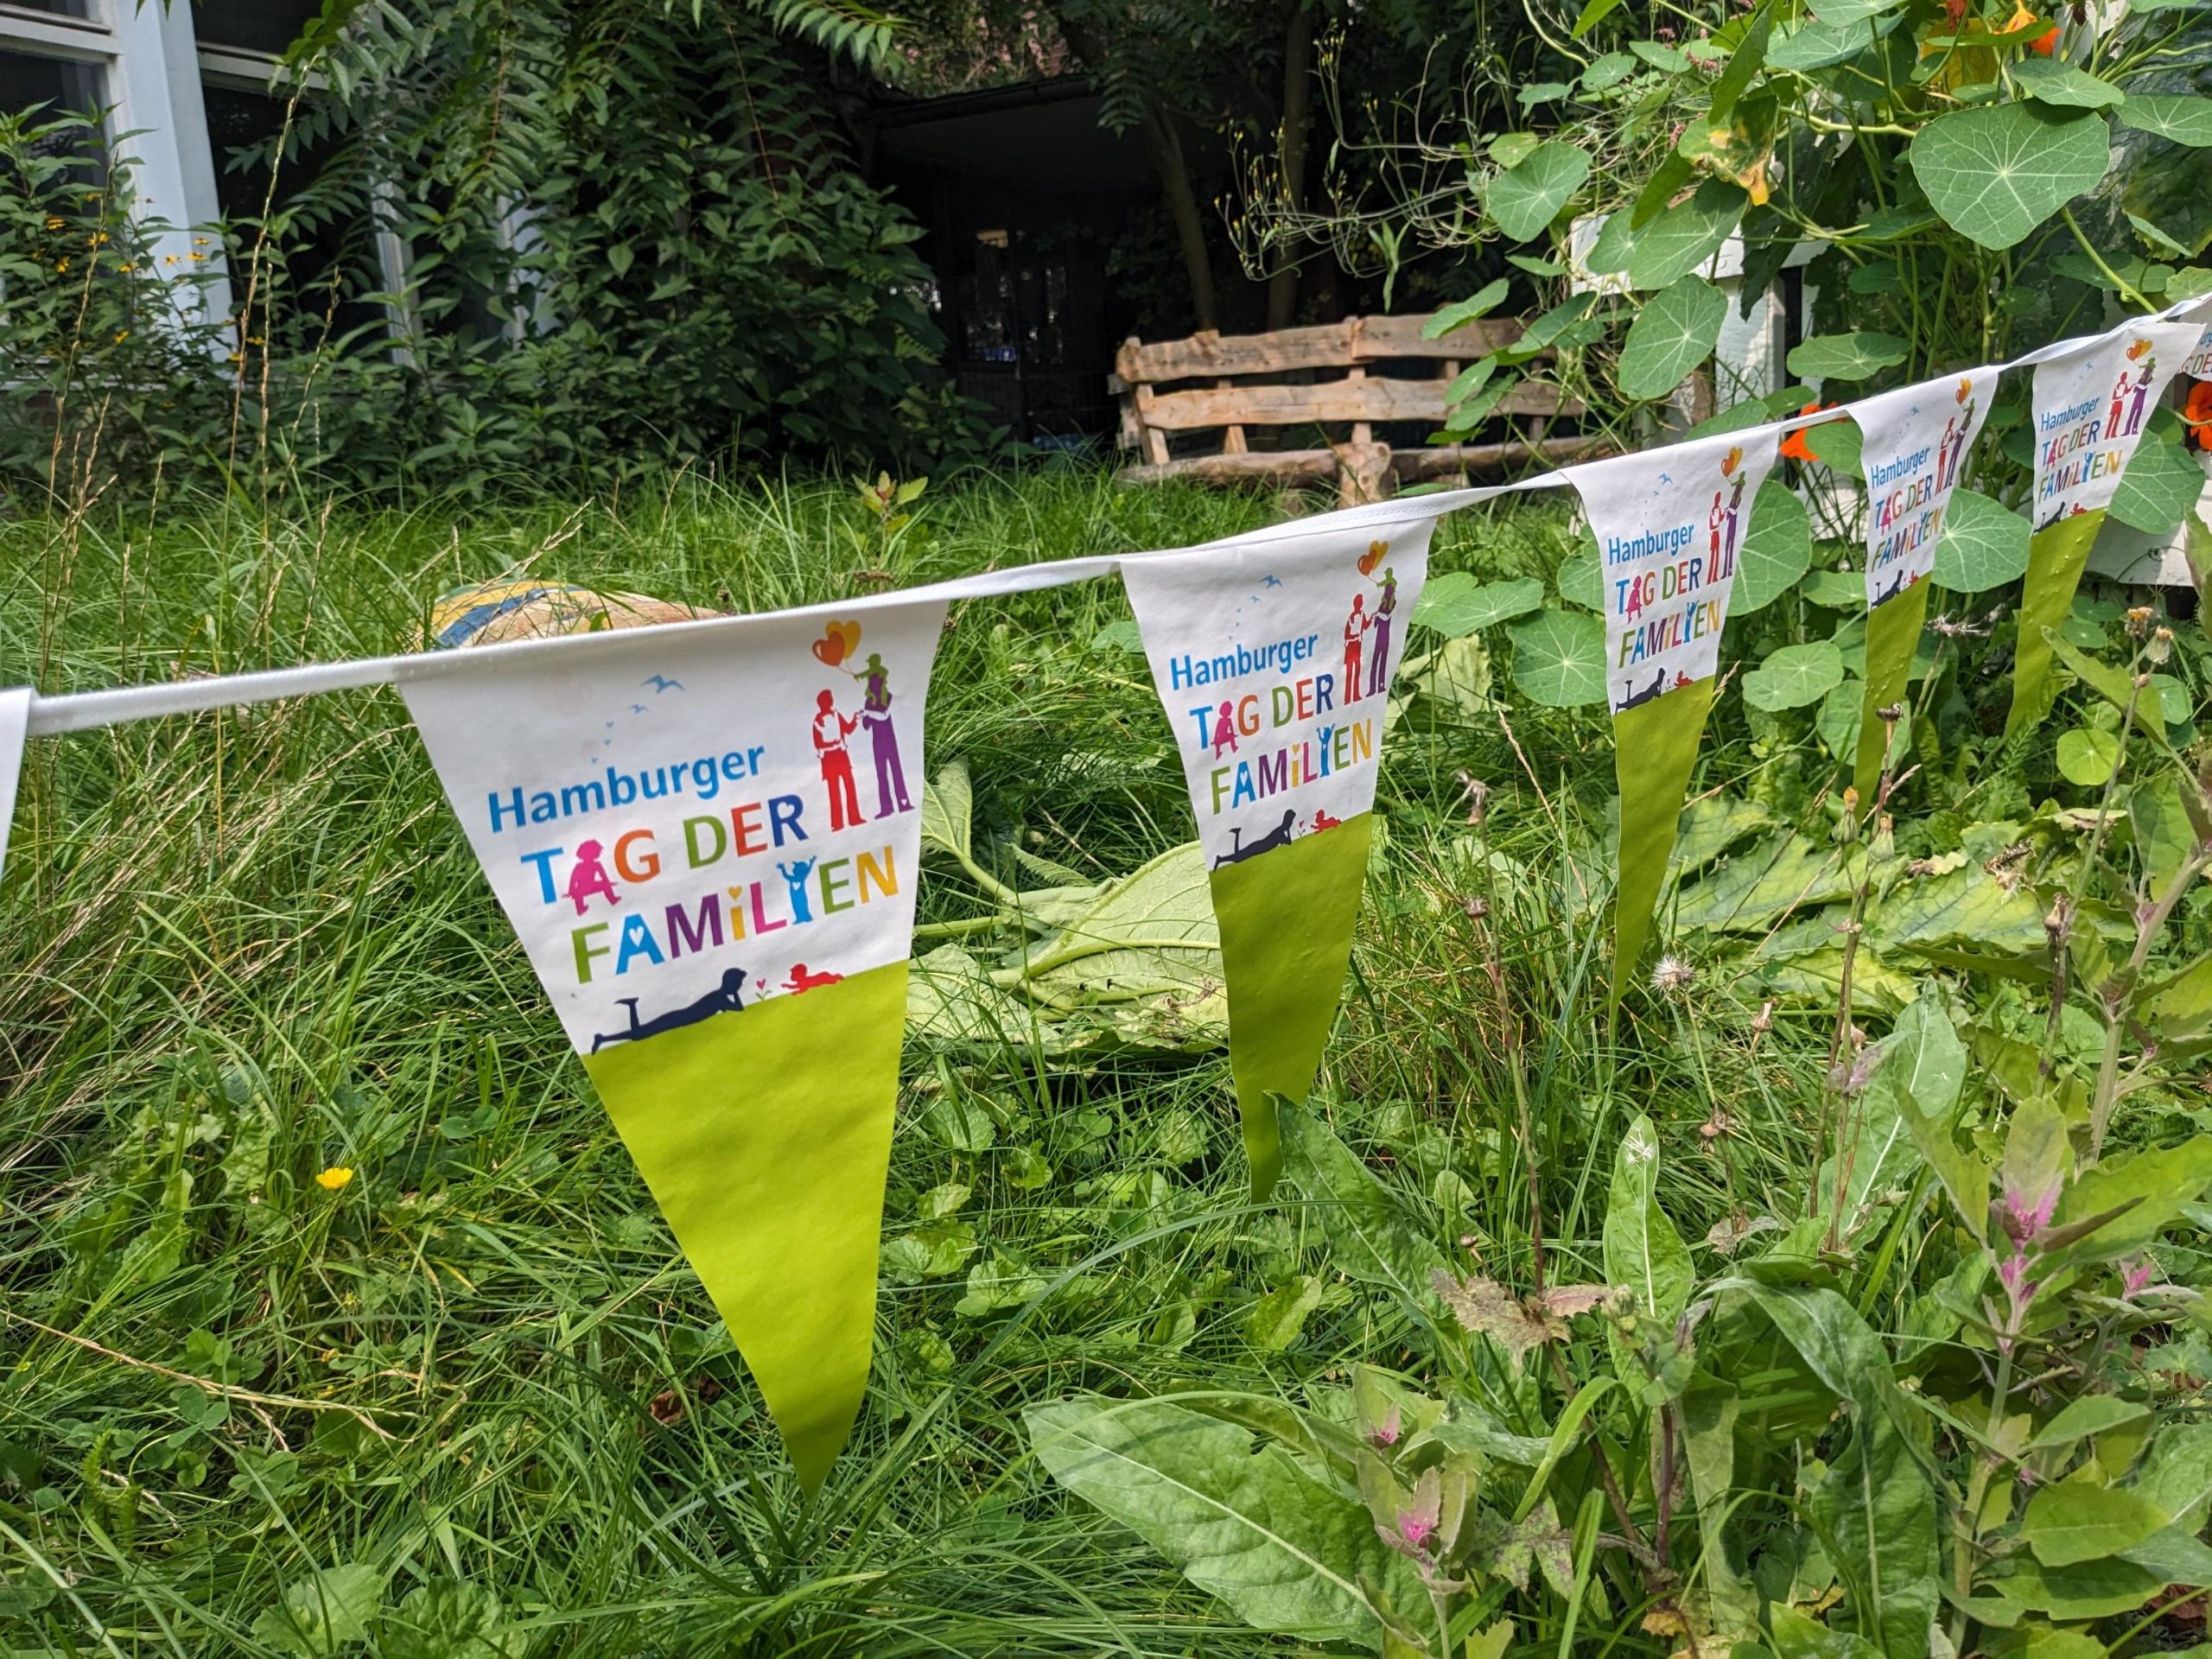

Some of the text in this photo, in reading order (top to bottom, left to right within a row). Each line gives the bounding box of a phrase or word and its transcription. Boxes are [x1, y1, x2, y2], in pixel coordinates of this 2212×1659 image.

[2191, 353, 2212, 374] DE
[2041, 397, 2099, 432] Hamburger
[2069, 420, 2100, 453] DER
[1872, 448, 1930, 488] Hamburger
[1906, 474, 1932, 512] DER
[1608, 524, 1694, 565] Hamburger
[1662, 558, 1701, 599] DER
[1171, 635, 1317, 690] Hamburger
[1273, 675, 1332, 727] DER
[488, 746, 765, 833] Hamburger
[683, 794, 809, 869] DER
